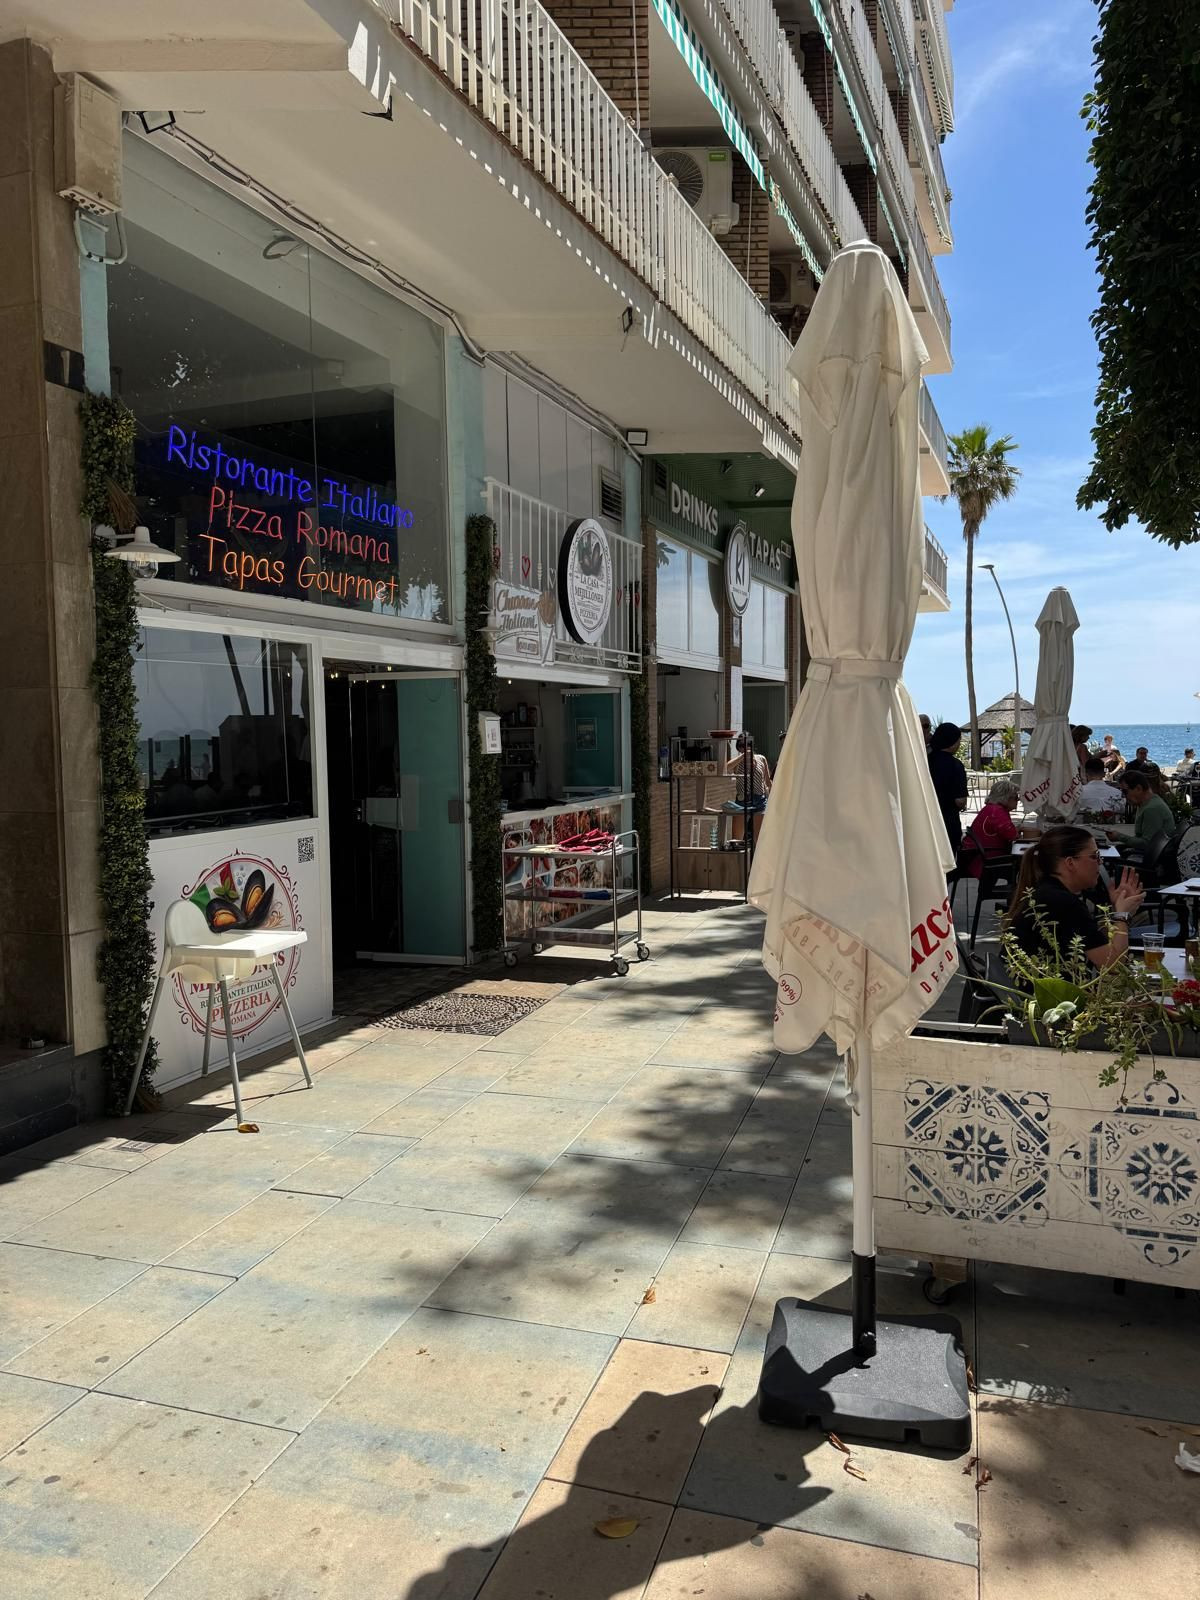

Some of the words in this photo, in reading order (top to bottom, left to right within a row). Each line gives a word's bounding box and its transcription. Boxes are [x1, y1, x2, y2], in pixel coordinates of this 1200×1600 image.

[166, 423, 313, 502] Ristorante
[322, 478, 415, 529] Italiano
[208, 485, 283, 540] Pizza
[296, 510, 391, 564] Romana
[670, 481, 719, 537] DRINKS
[198, 533, 285, 590] Tapas
[297, 555, 399, 605] Gourmet
[749, 530, 782, 571] TAPAS
[200, 986, 247, 1009] RITOANTE
[246, 977, 276, 994] ITALIAN
[231, 1010, 257, 1025] OMANA
